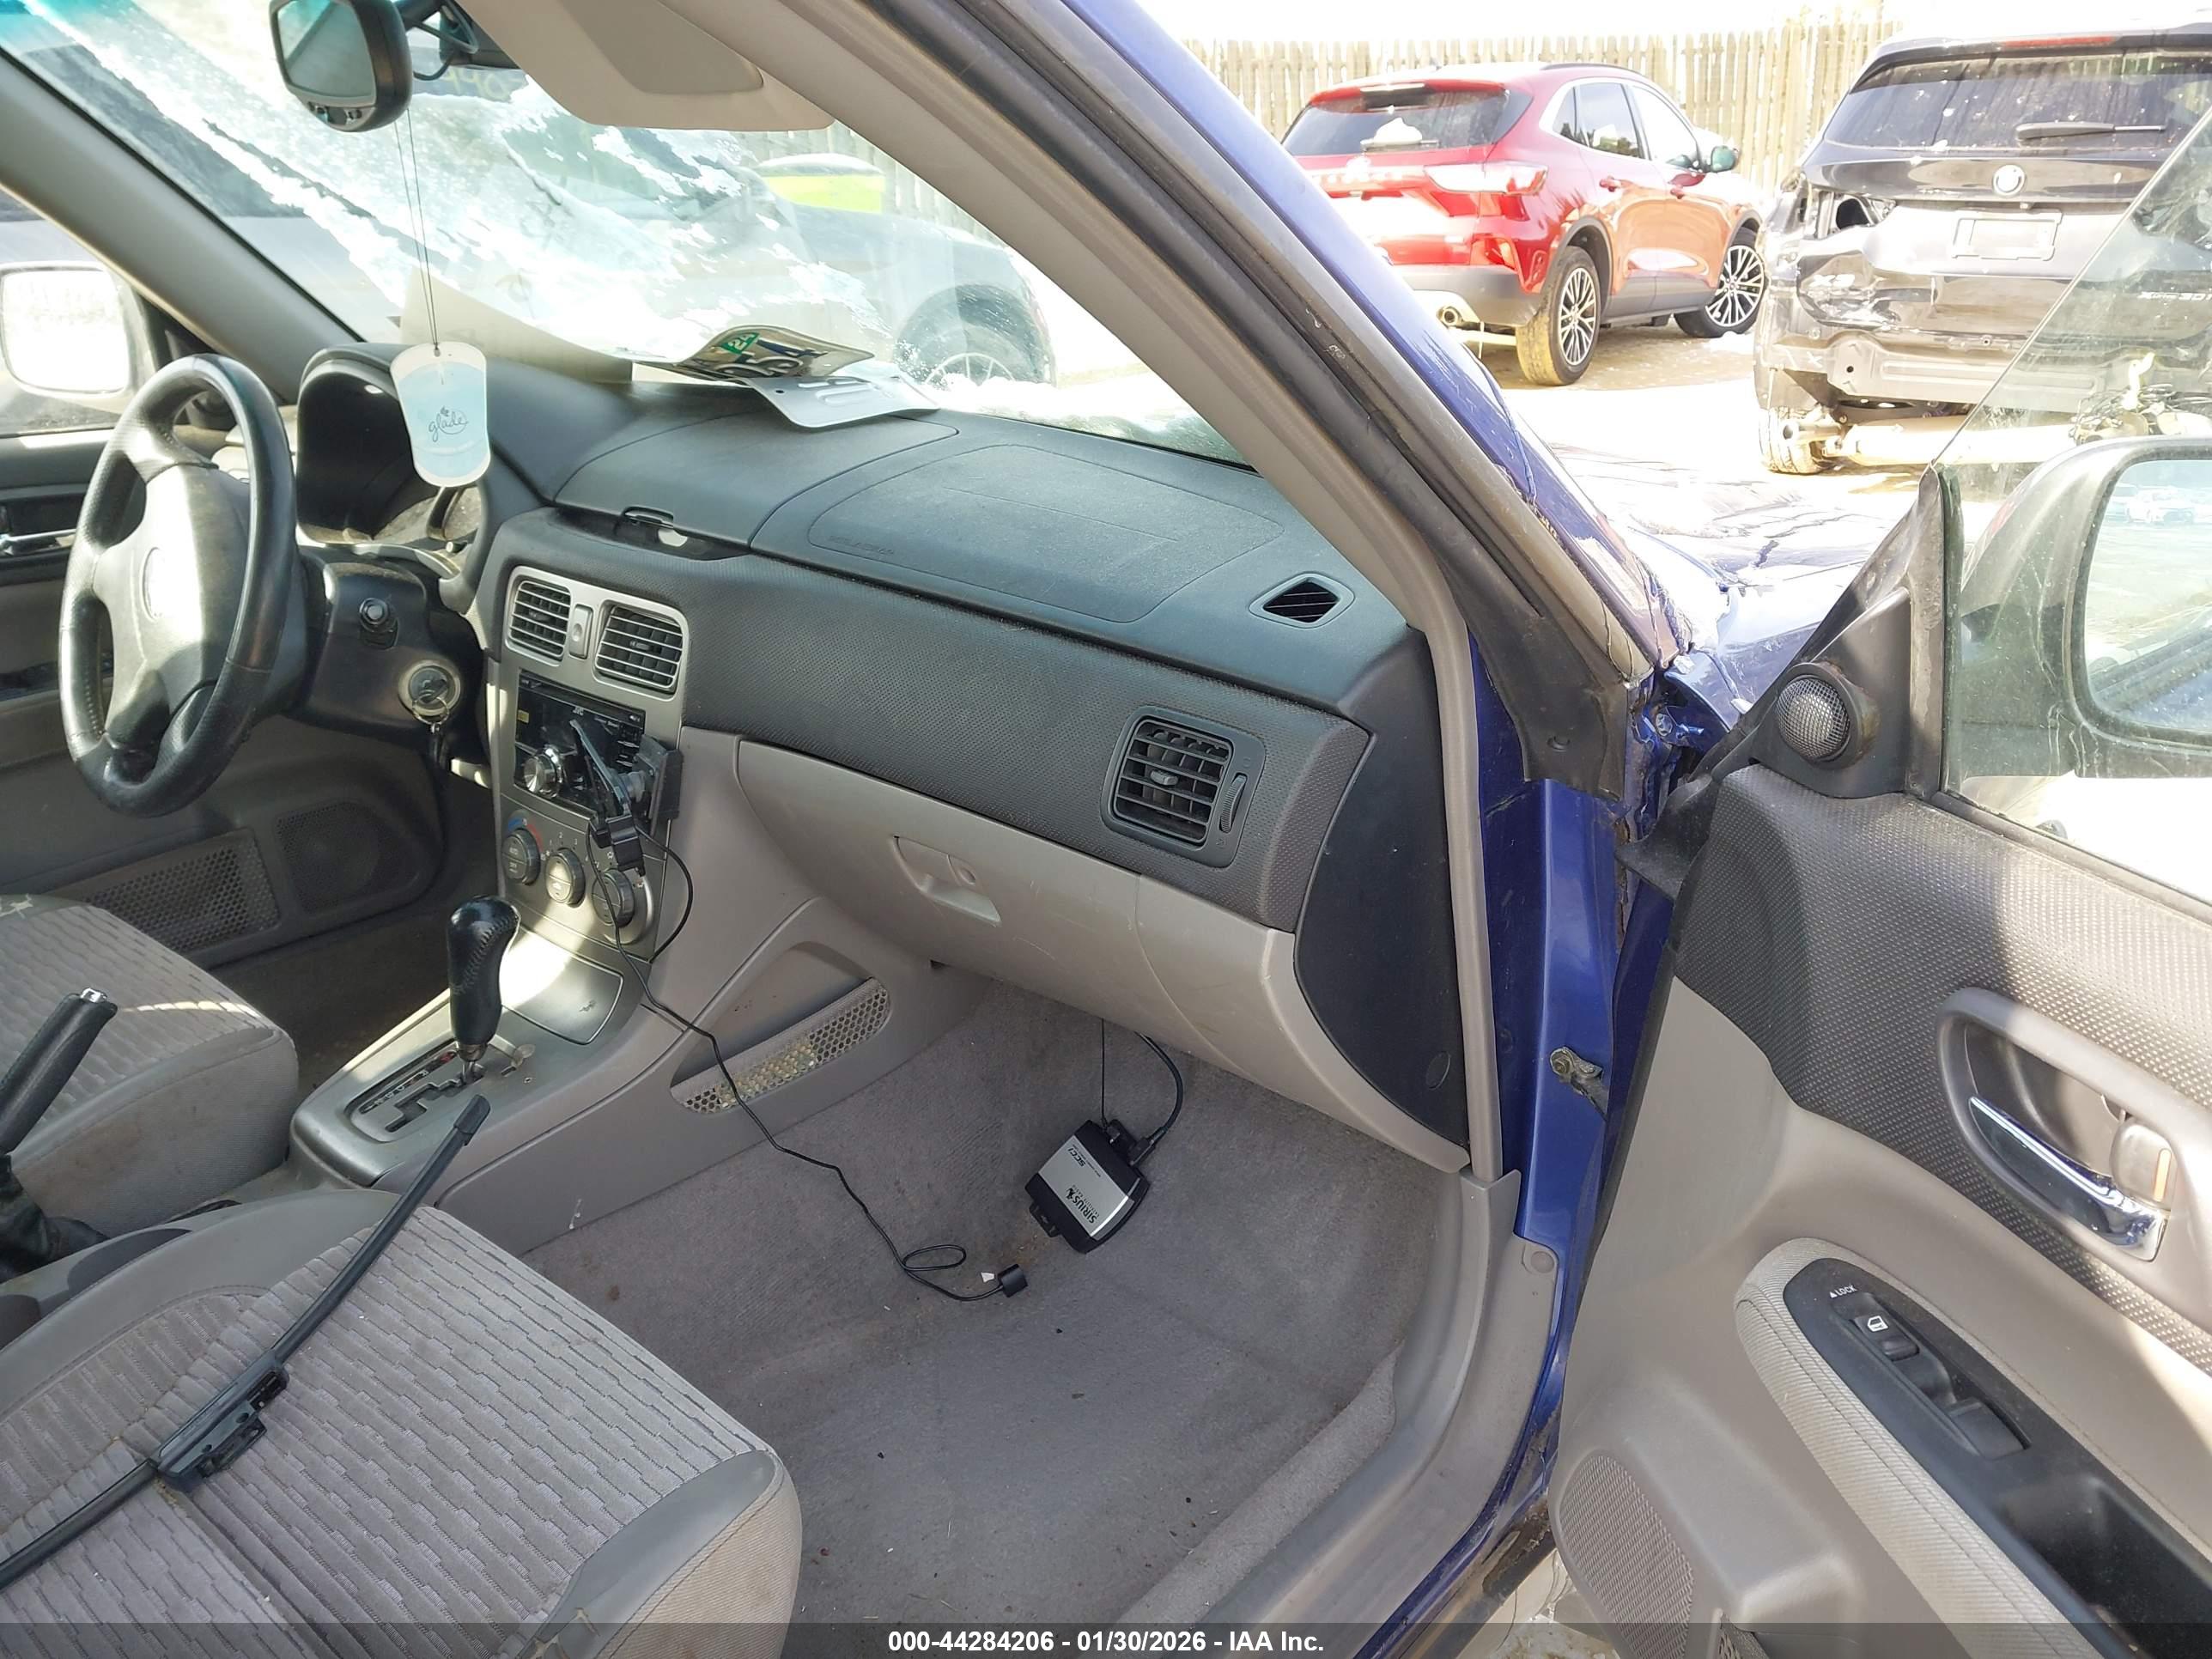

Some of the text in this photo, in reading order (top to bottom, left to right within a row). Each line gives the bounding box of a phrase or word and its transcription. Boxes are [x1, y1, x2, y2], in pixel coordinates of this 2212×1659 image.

[1808, 274, 1855, 287] X3
[428, 411, 469, 442] glade
[1072, 1195, 1097, 1224] SIRIUS
[1834, 1285, 1857, 1296] LOCK
